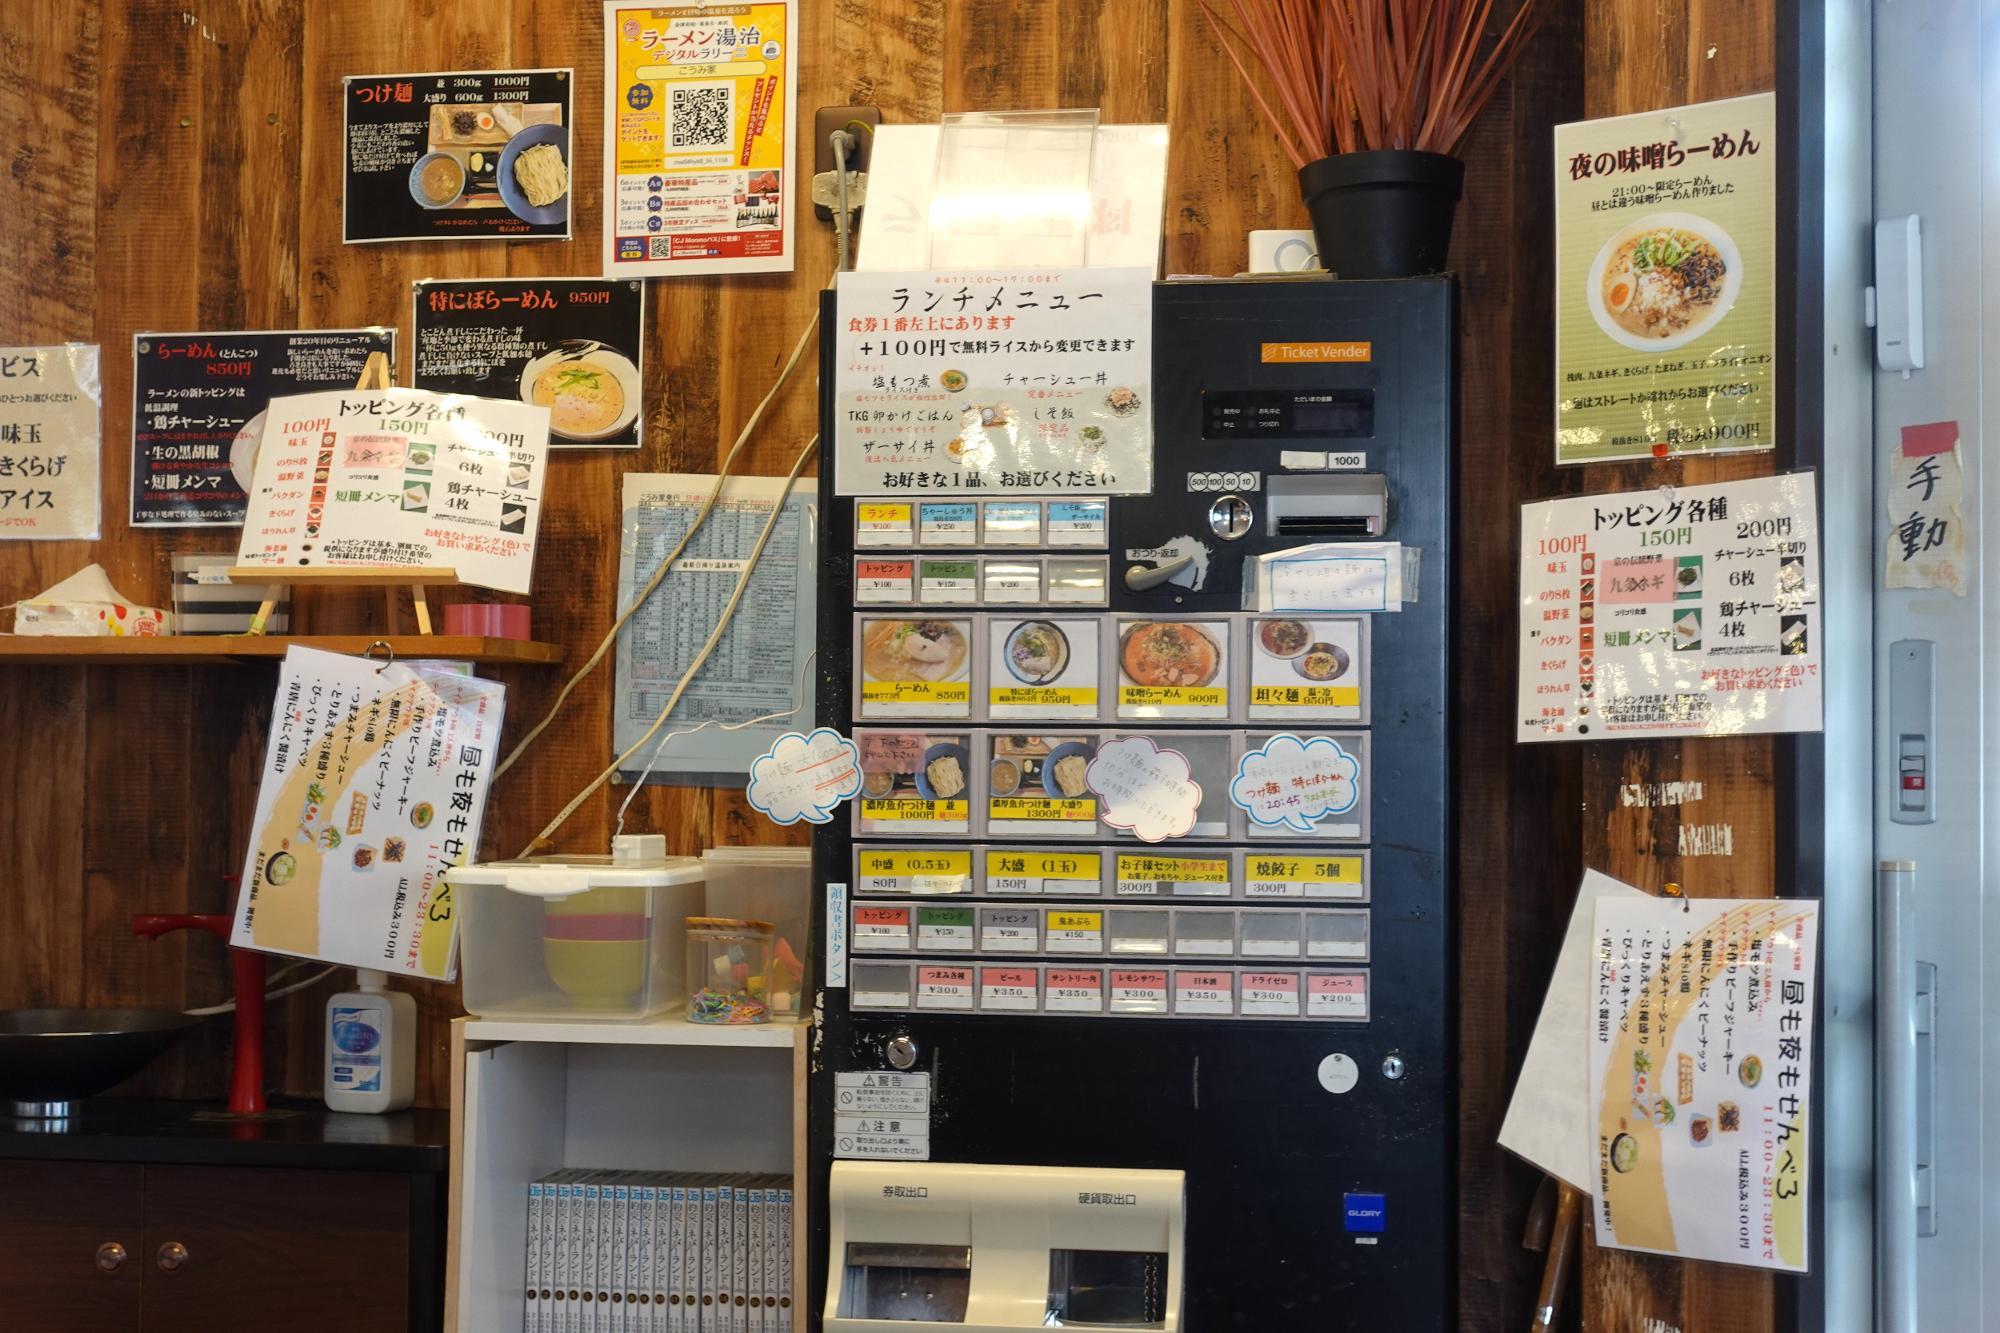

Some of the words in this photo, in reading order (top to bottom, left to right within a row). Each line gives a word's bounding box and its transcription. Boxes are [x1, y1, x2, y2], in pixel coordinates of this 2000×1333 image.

[642, 26, 760, 49] ラーメン湯治
[652, 48, 733, 61] デジタルラリー
[356, 82, 413, 103] つけ麺
[453, 78, 482, 87] 300g
[493, 76, 530, 86] 1000円
[423, 93, 447, 103] 大盛り
[493, 91, 529, 101] 1300円
[1569, 129, 1761, 181] 夜の味噌らーめん
[1591, 183, 1734, 212] 昼とは違う味噌らーめん作りました
[430, 289, 558, 311] 特にぼらーめん
[569, 291, 610, 304] 950円
[891, 285, 1104, 314] ランチメニュー
[848, 316, 1016, 333] 食券1番左上にあります
[158, 343, 216, 360] らーめん
[860, 338, 1136, 358] +100円で無料ライスから変更できます
[1281, 346, 1318, 358] Ticket
[1322, 346, 1368, 358] Vender
[2, 356, 40, 377] ビス
[206, 362, 252, 376] 850円
[872, 373, 931, 389] 塩もつ煮
[1003, 371, 1108, 386] チャーシュー丼
[147, 387, 245, 398] ラーメンの新トッピングは
[848, 410, 869, 421] TKG
[873, 410, 953, 421] 卵かけごはん
[1034, 407, 1075, 419] しそ飯
[283, 418, 330, 433] 100円
[378, 419, 429, 435] 150円
[1, 423, 41, 444] 味玉
[1667, 422, 1760, 444] 税込み900円
[288, 437, 308, 447] 味玉
[863, 440, 935, 453] ザーサイ丼
[0, 455, 66, 477] きくらげ
[277, 457, 308, 466] のり8枚
[1334, 456, 1360, 465] 1000
[459, 462, 484, 476] 6枚
[277, 472, 304, 481] 温野菜
[882, 470, 1116, 489] お好きな1品、お選びください
[1192, 478, 1206, 486] 500
[1208, 478, 1222, 486] 100
[1226, 478, 1236, 486] 50
[1242, 478, 1250, 486] 10
[335, 490, 400, 503] 短冊メンマ
[448, 481, 537, 503] 鶏チャーシュー
[1, 489, 54, 509] アイス
[445, 497, 469, 511] 4枚
[269, 509, 295, 518] きくらげ
[866, 509, 898, 518] ランチ
[1594, 497, 1728, 531] トッピング各種
[1899, 456, 1948, 561] 手動
[262, 527, 296, 535] ほうれん草
[1640, 527, 1692, 547] 150円
[1737, 517, 1792, 539] 200円
[436, 540, 517, 557] お買い求めください
[1538, 533, 1587, 556] 100円
[323, 546, 432, 559] 提供になりますが盛り付け希望の
[1131, 548, 1179, 558] おつり・返却
[866, 565, 904, 573] トッピング
[930, 565, 966, 573] トッピング
[1547, 561, 1568, 573] 味玉
[1729, 572, 1755, 587] 6枚
[1539, 588, 1571, 601] のり8枚
[1543, 608, 1570, 621] 温野菜
[1614, 608, 1647, 616] コリコリ食感
[1720, 600, 1817, 617] 鶏チャーシュー
[1719, 621, 1745, 638] 4枚
[1604, 630, 1671, 648] 短冊メンマ
[1540, 660, 1567, 671] きくらげ
[895, 684, 930, 693] らーめん
[1536, 683, 1570, 693] ほうれん草
[1715, 678, 1802, 691] お買い求めください
[936, 691, 965, 700] 850円
[1010, 688, 1058, 696] 特にぼらーめん
[1126, 689, 1182, 698] 味噌らーめん
[1041, 696, 1070, 704] 950円
[1188, 695, 1218, 703] 900円
[1303, 696, 1334, 705] 950円
[866, 800, 935, 810] 濃厚魚介つけ麺
[992, 799, 1050, 809] 濃厚魚介つけ麺
[1059, 800, 1083, 809] 大盛り
[900, 811, 934, 819] 1000円
[1026, 809, 1061, 819] 1300円
[872, 859, 894, 870] 中盛
[907, 859, 950, 870] (0.5玉)
[999, 859, 1024, 872] 大盛
[1041, 860, 1077, 872] (1玉)
[1120, 859, 1180, 871] お子様セット
[1256, 862, 1300, 876] 焼餃子
[1315, 864, 1340, 877] 5個
[872, 879, 897, 888] 80円
[996, 879, 1026, 889] 150円
[1120, 883, 1152, 892] 300円
[1253, 883, 1286, 893] 300円
[862, 911, 902, 920] トッピング
[927, 912, 964, 920] トッピング
[992, 915, 1028, 923] トッピング
[927, 971, 965, 980] つまみ各種
[1000, 974, 1021, 982] ビール
[1052, 975, 1096, 983] サントリー角
[1119, 975, 1162, 983] レモンサワー
[1252, 977, 1288, 985] ドライゼロ
[993, 988, 1022, 996] ¥350
[1124, 990, 1154, 998] ¥300
[1187, 991, 1217, 999] ¥350
[1253, 992, 1283, 1000] ¥300
[879, 1075, 902, 1086] 警告
[1776, 979, 1806, 1200] 昼も夜もせんべろ
[874, 1121, 901, 1132] 注意
[882, 1186, 928, 1198] 券取出口
[1739, 1148, 1749, 1248] ALL税込み300円
[1078, 1192, 1137, 1205] 硬貨取出口
